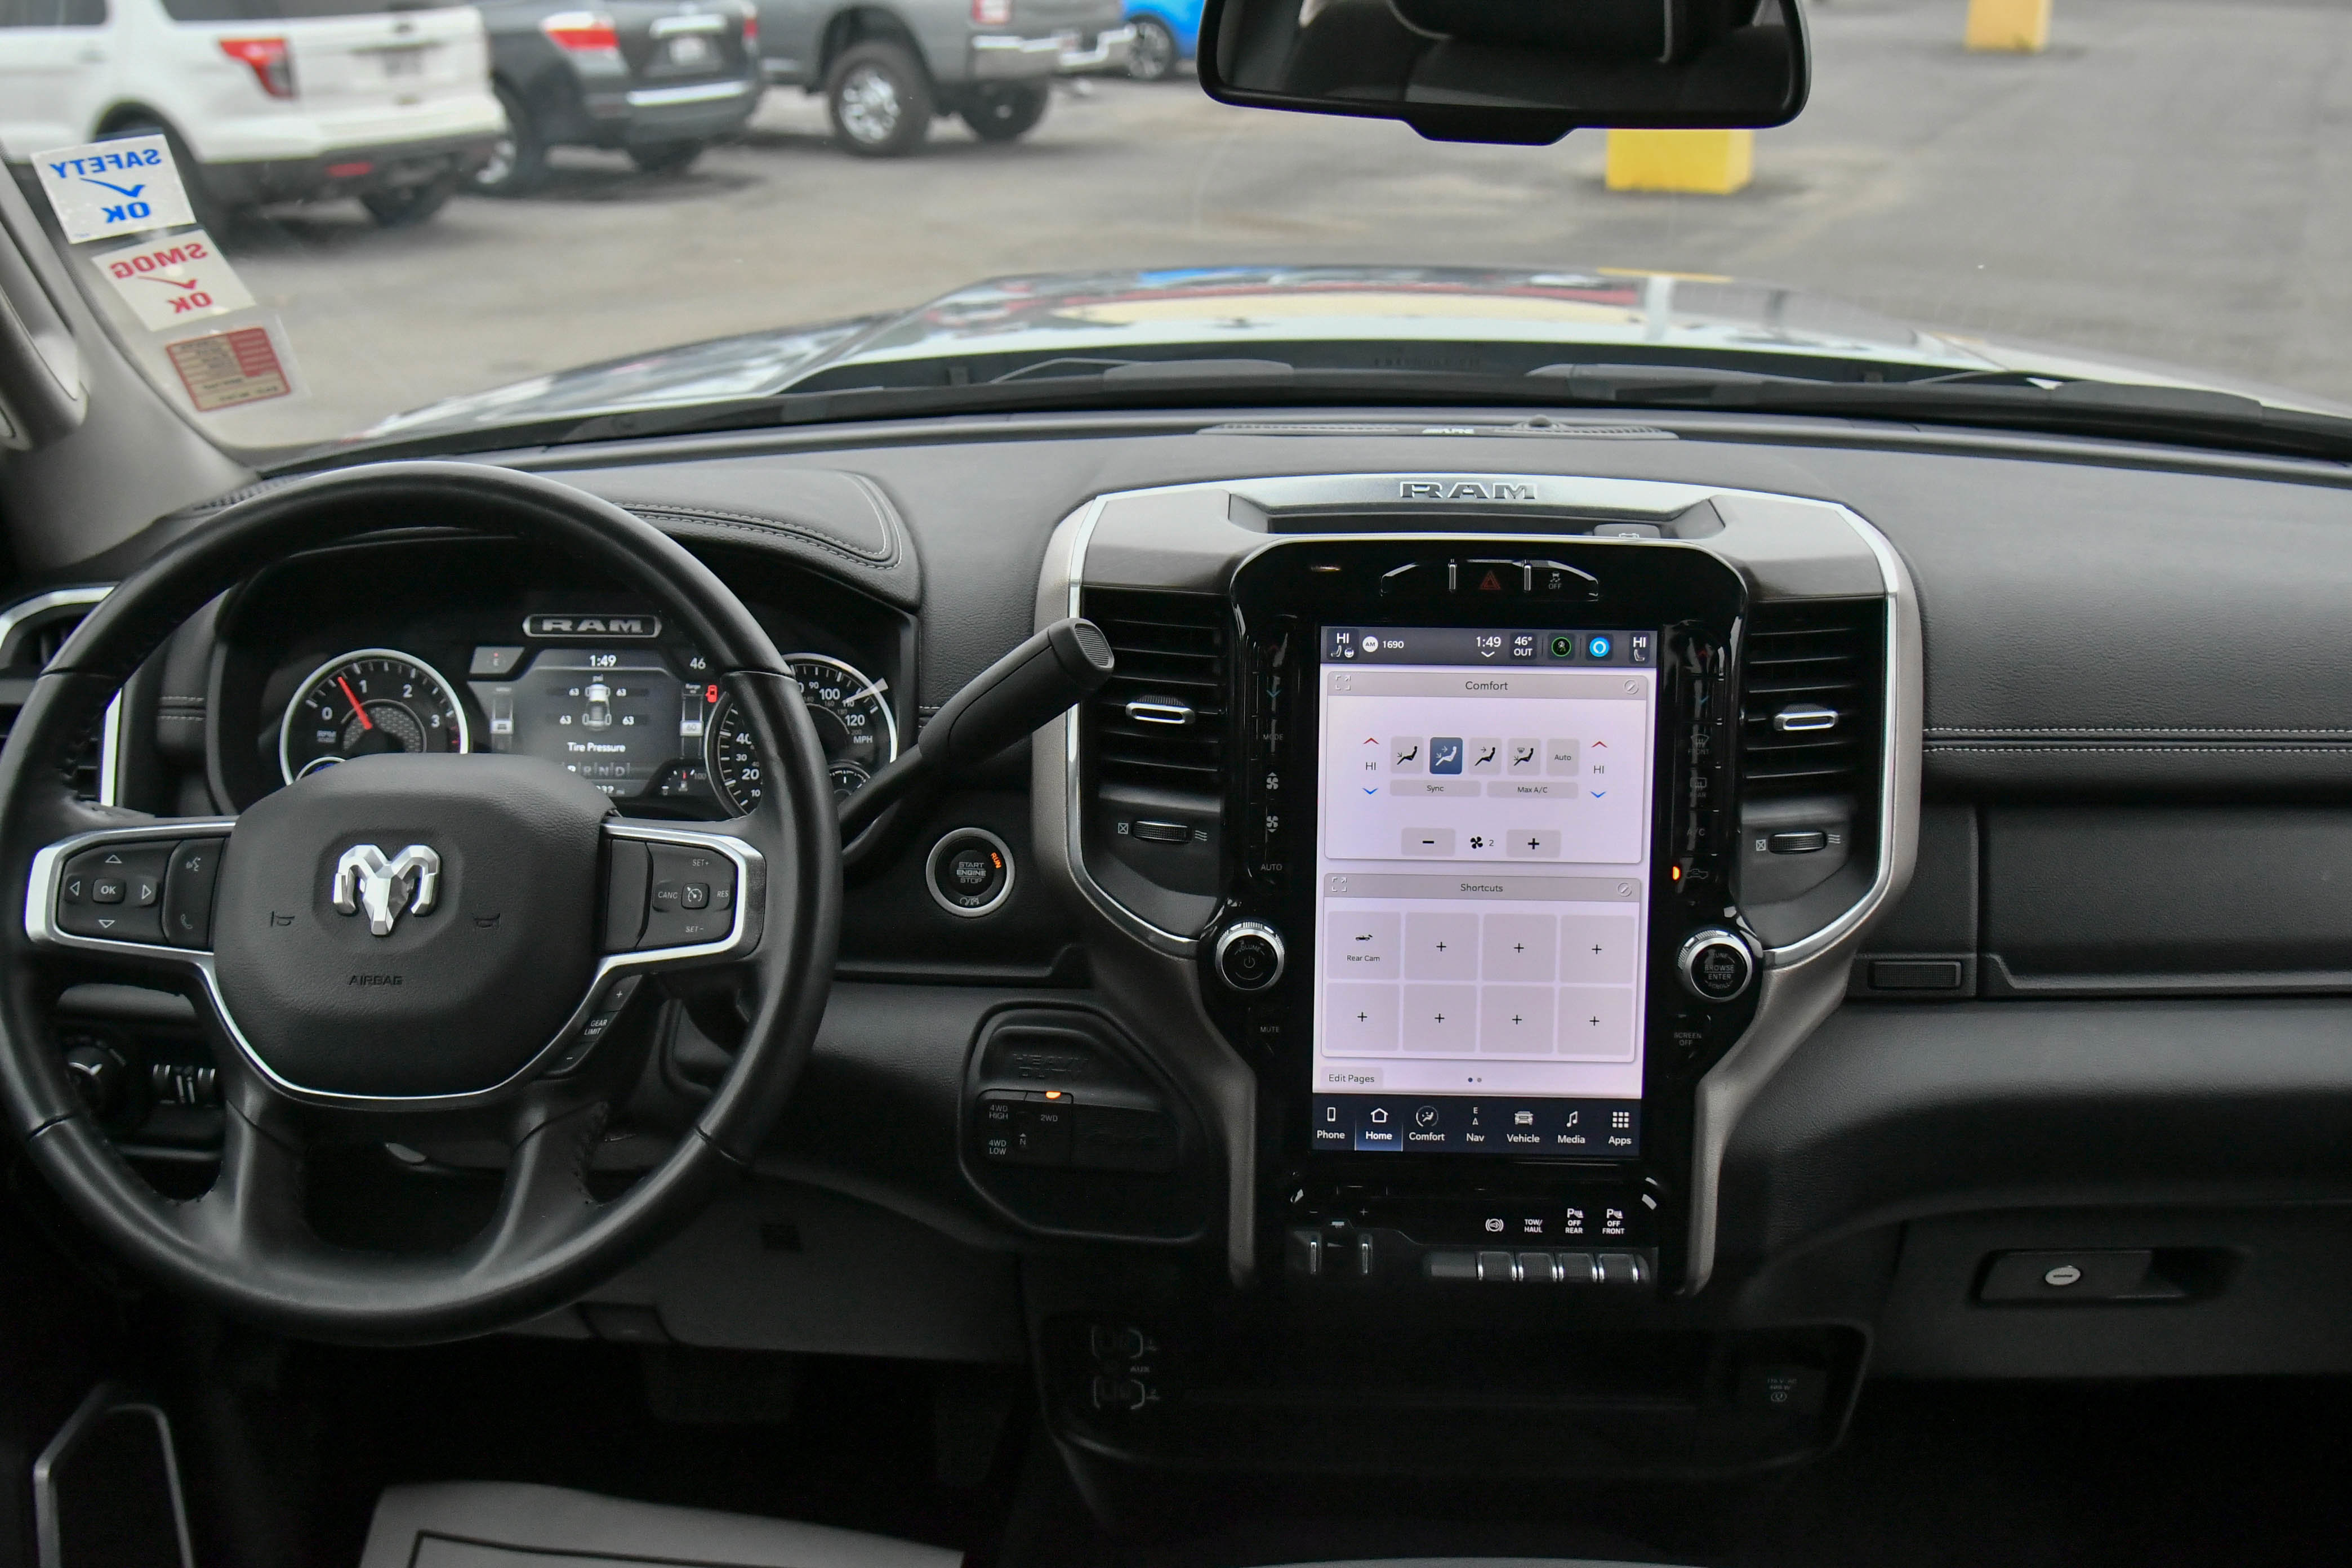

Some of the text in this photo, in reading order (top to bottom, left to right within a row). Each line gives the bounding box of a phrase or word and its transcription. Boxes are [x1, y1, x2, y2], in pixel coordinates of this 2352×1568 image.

[1400, 481, 1537, 500] RAM
[542, 619, 643, 632] RAM
[1337, 633, 1349, 644] HI
[1476, 636, 1501, 648] 1:49
[1633, 637, 1646, 648] HI
[1383, 640, 1404, 649] 1690
[1513, 648, 1533, 657] OUT
[590, 655, 617, 666] 1:49
[690, 658, 706, 670] 46
[359, 680, 367, 693] 1
[808, 681, 819, 689] 90
[1465, 680, 1509, 691] Comfort
[403, 684, 412, 698] 2
[569, 688, 626, 697] 63 63
[819, 688, 840, 700] 100
[322, 707, 333, 721] 0
[431, 714, 440, 728] 3
[560, 716, 634, 725] 63 63
[845, 714, 865, 726] 120
[567, 742, 626, 752] Tire Pressure
[1366, 753, 1604, 774] HI Auto HI
[599, 767, 609, 776] N
[616, 766, 625, 776] D
[741, 768, 760, 781] 20
[1427, 785, 1444, 794] Sync
[991, 852, 1002, 868] RUN
[101, 886, 117, 895] OK
[1460, 883, 1503, 893] Shortcuts
[349, 975, 403, 985] AIRBAG
[1328, 1073, 1375, 1085] Edit Pages
[1317, 1130, 1632, 1147] Phone Home Comfort Nav Vehicle Media Apps
